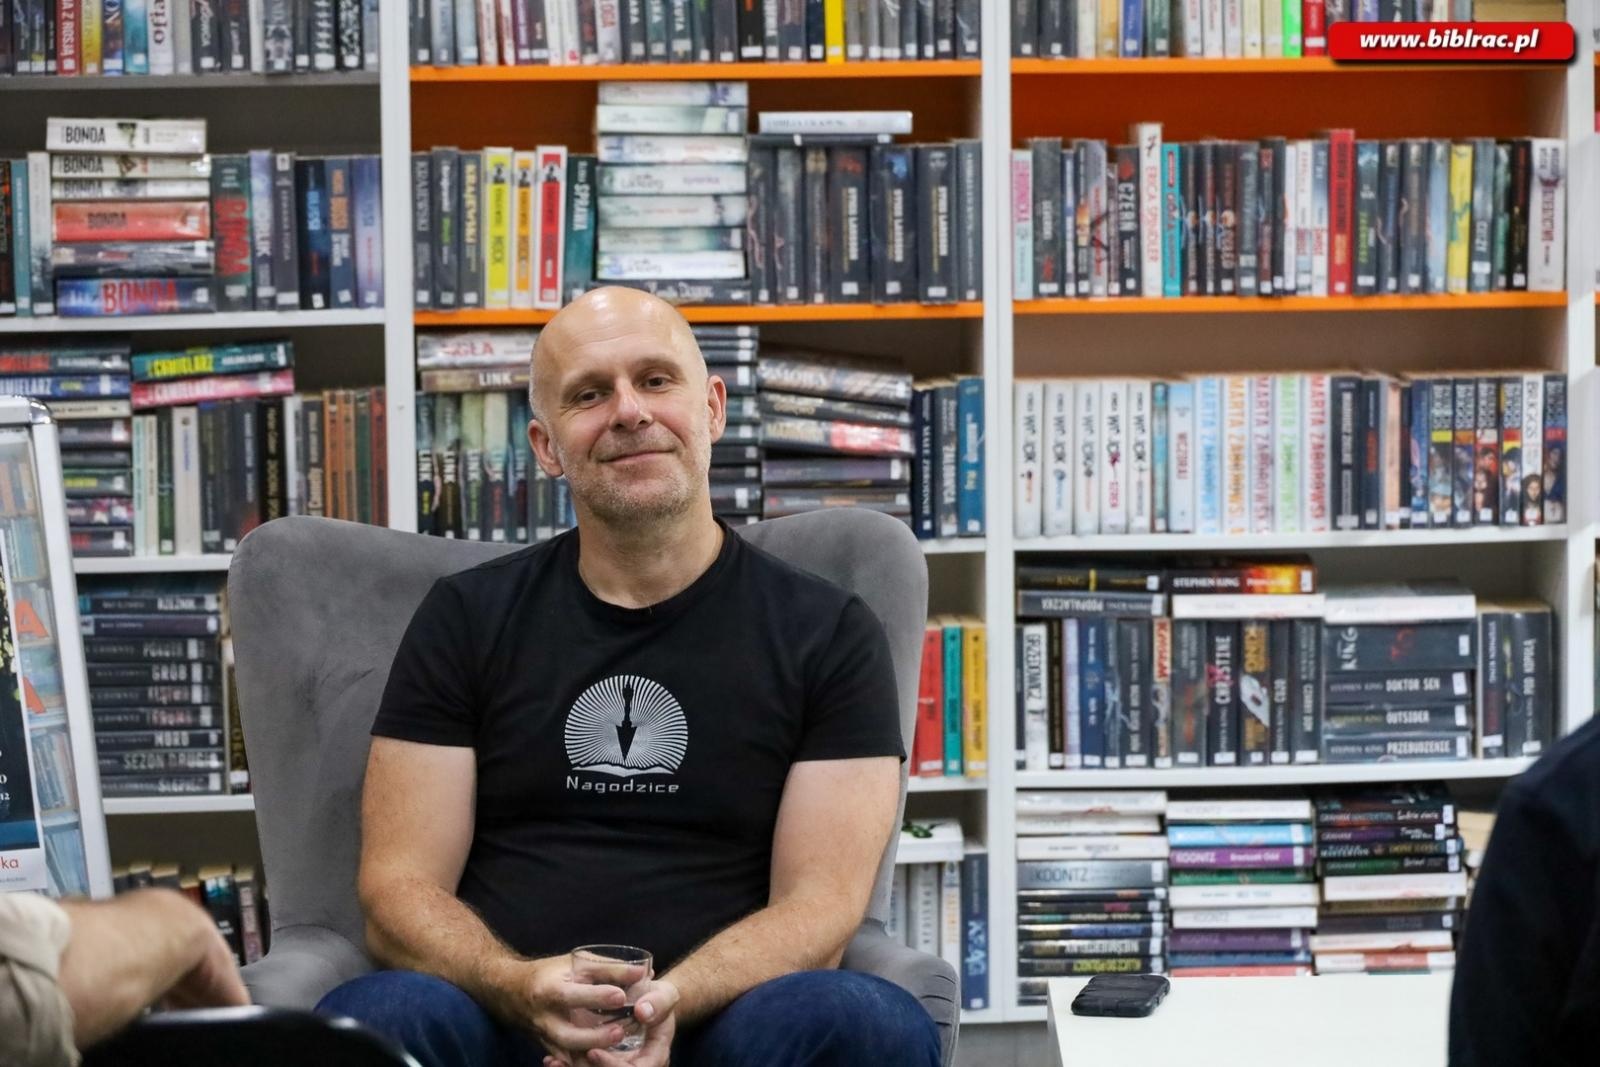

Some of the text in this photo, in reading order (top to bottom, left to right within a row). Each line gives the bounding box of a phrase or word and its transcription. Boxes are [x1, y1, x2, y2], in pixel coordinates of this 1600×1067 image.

[60, 22, 77, 56] ROSJĄ
[65, 126, 106, 144] BONDA
[63, 156, 104, 174] BONDA
[573, 184, 591, 231] SPRAWA
[87, 213, 127, 230] BONDA
[215, 198, 249, 277] BONDA
[103, 280, 179, 313] BONDA
[479, 372, 512, 387] LINK
[1254, 376, 1270, 427] MARTA
[1309, 376, 1327, 427] MARTA
[1172, 577, 1240, 588] STEPHEN KING
[14, 599, 50, 638] A
[1340, 627, 1358, 670] KING
[1215, 635, 1232, 704] CHRISTINE
[1386, 678, 1420, 692] DOKTOR
[1422, 677, 1441, 691] SEN
[1386, 710, 1430, 724] OUTSIDER
[1387, 740, 1451, 755] PRZEBUDZENIE
[566, 775, 680, 794] Nagodzice
[1175, 850, 1217, 864] KOONTZ
[1034, 866, 1089, 884] KOONTZ
